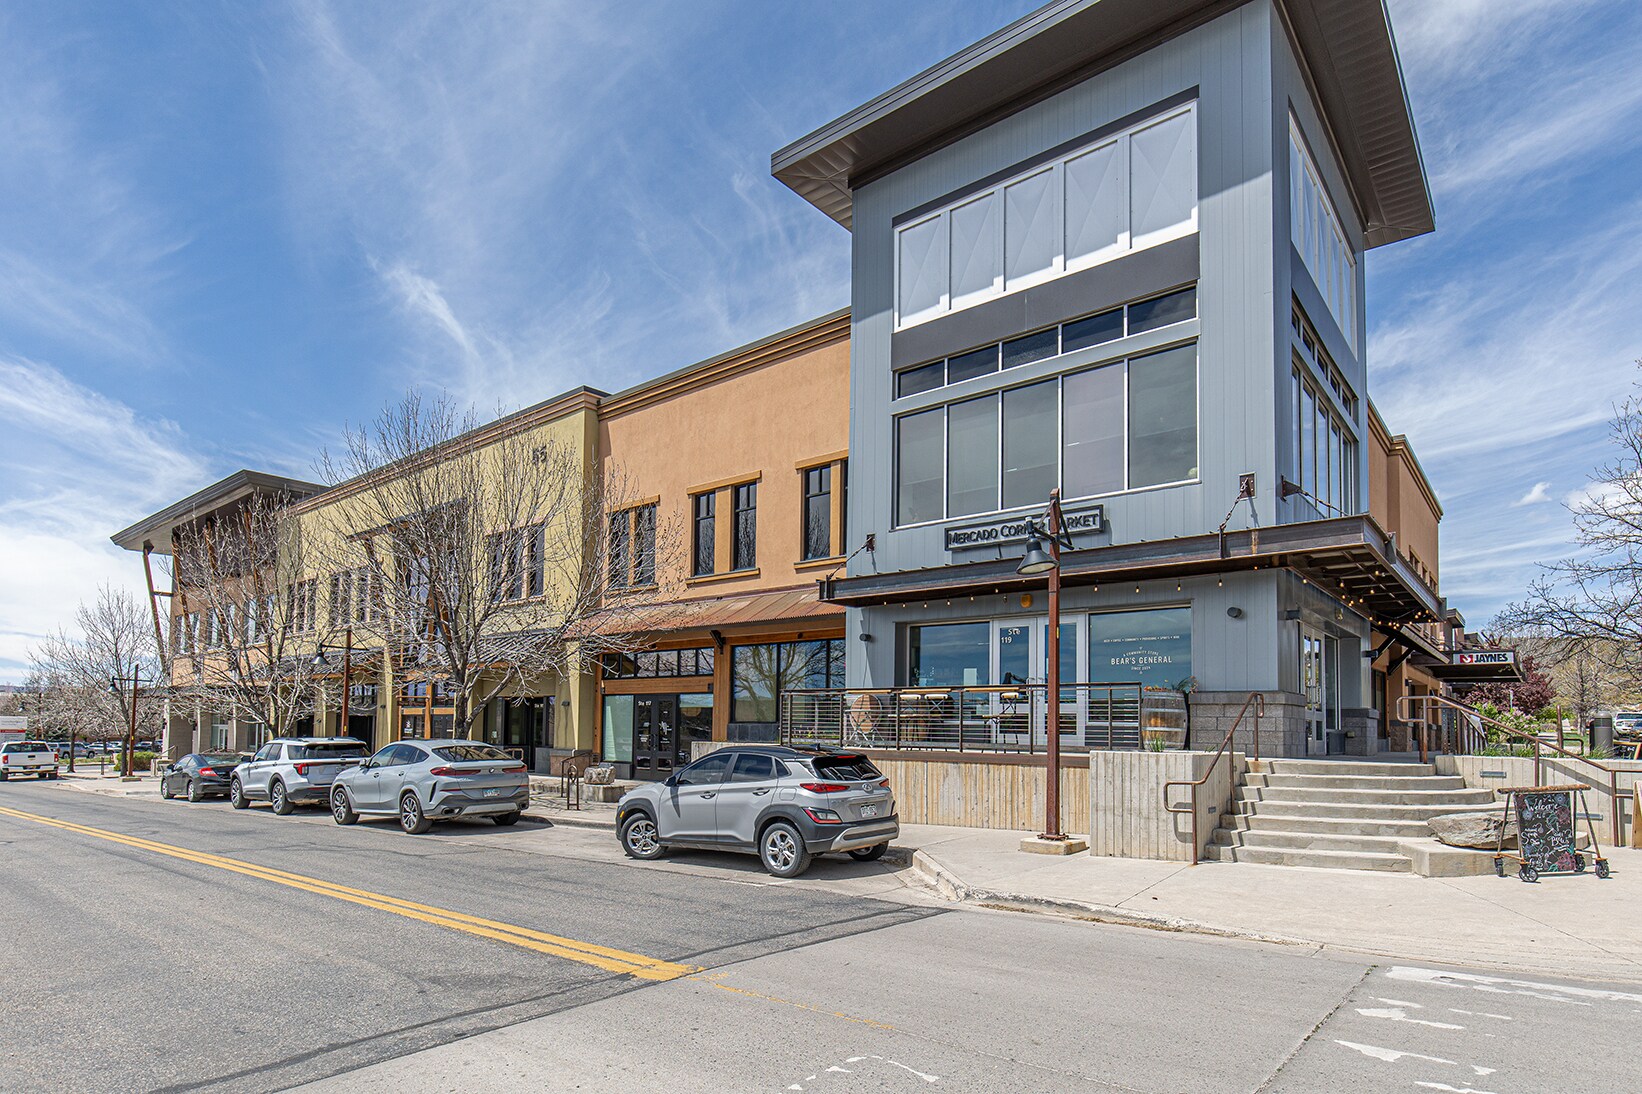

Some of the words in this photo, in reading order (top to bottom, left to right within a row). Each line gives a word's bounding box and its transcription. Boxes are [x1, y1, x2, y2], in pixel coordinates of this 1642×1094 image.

[949, 527, 998, 545] MERCADO
[1048, 513, 1099, 531] RKET
[1111, 657, 1136, 665] BEAR'S
[1138, 655, 1172, 664] GENERAL
[1474, 653, 1508, 663] JAYNES
